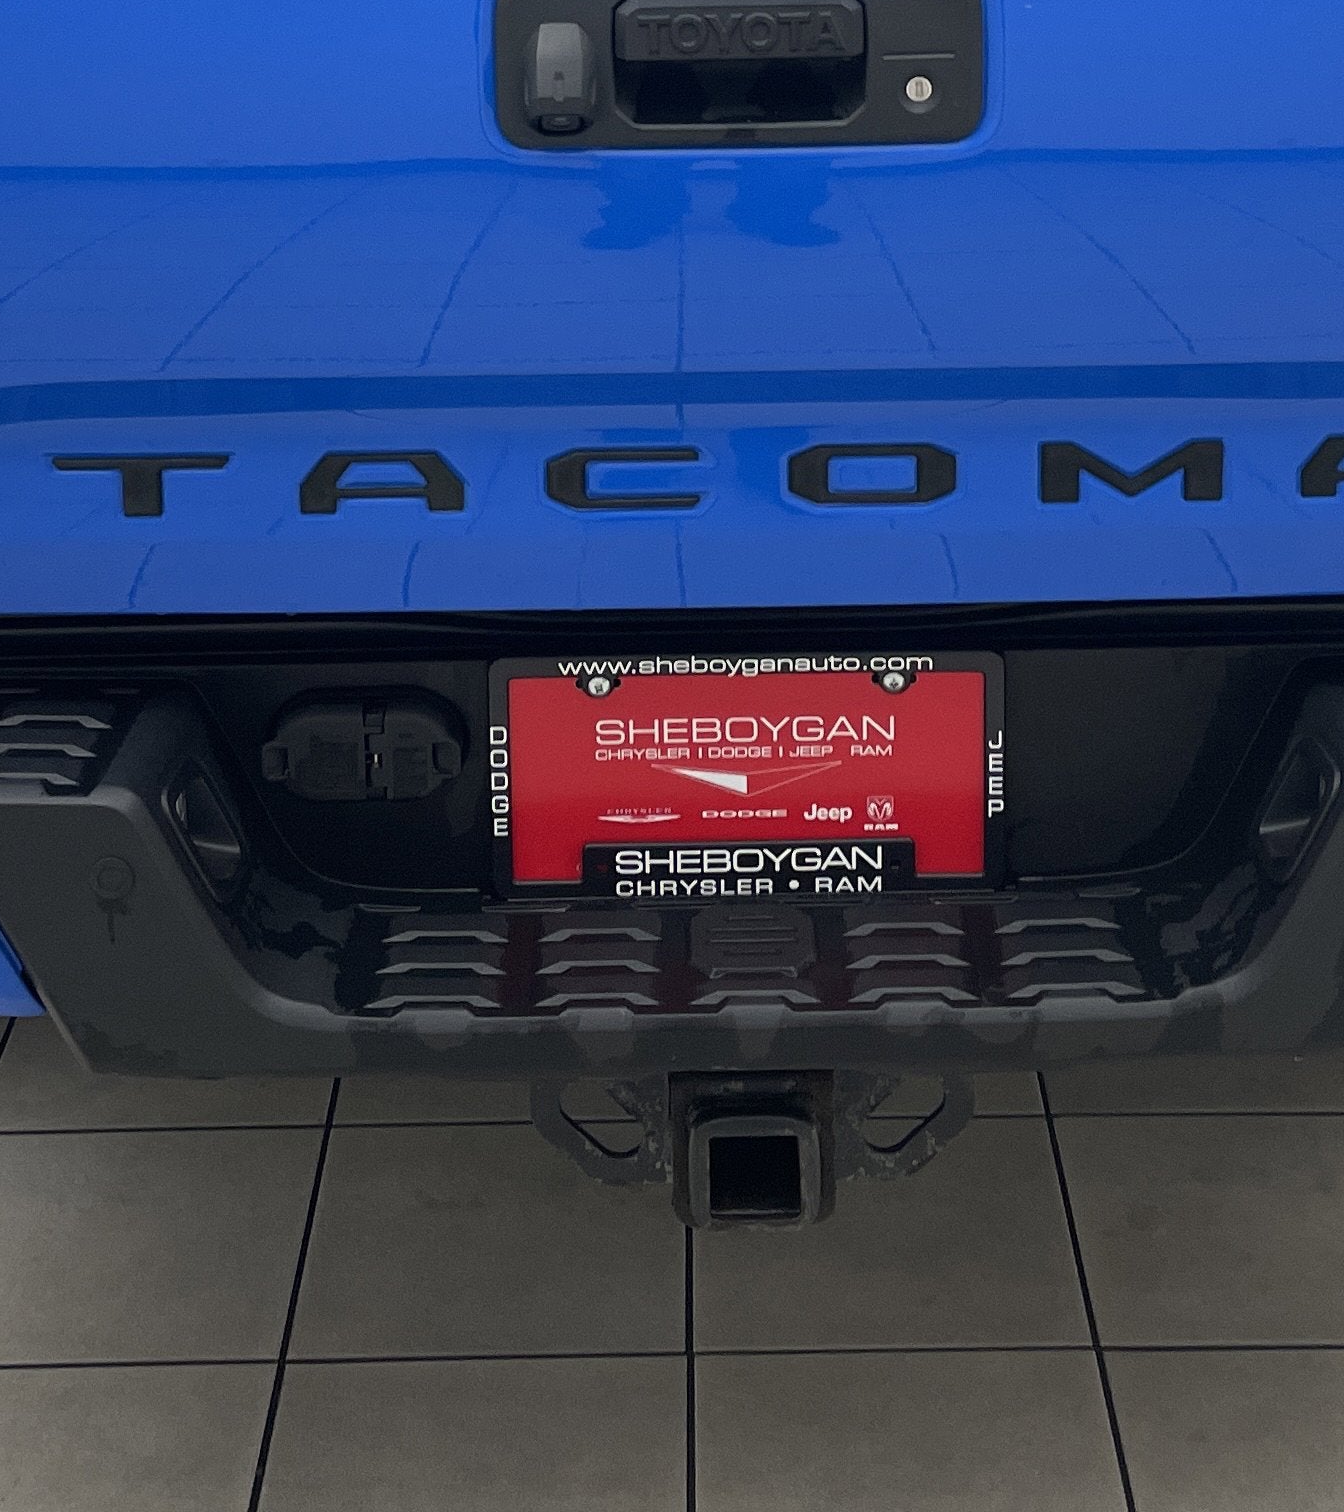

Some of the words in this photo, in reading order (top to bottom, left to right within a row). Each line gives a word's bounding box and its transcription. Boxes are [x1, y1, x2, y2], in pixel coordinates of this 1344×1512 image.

[636, 11, 846, 55] TOYOTA
[558, 654, 934, 677] www.sheboyganauto.com
[595, 715, 896, 746] SHEBOYGAN
[595, 748, 690, 761] CHRYSLER
[708, 746, 772, 759] DODGE
[789, 745, 834, 758] JEEP
[851, 744, 893, 757] RAM
[489, 725, 509, 837] DODGE
[988, 729, 1004, 818] JEEP
[702, 809, 787, 819] DODGE
[804, 803, 853, 824] Jeep
[864, 823, 899, 831] RAM
[615, 845, 883, 874] SHEBOYGAN
[616, 879, 774, 897] CHRYSLER
[815, 876, 883, 895] RAM
